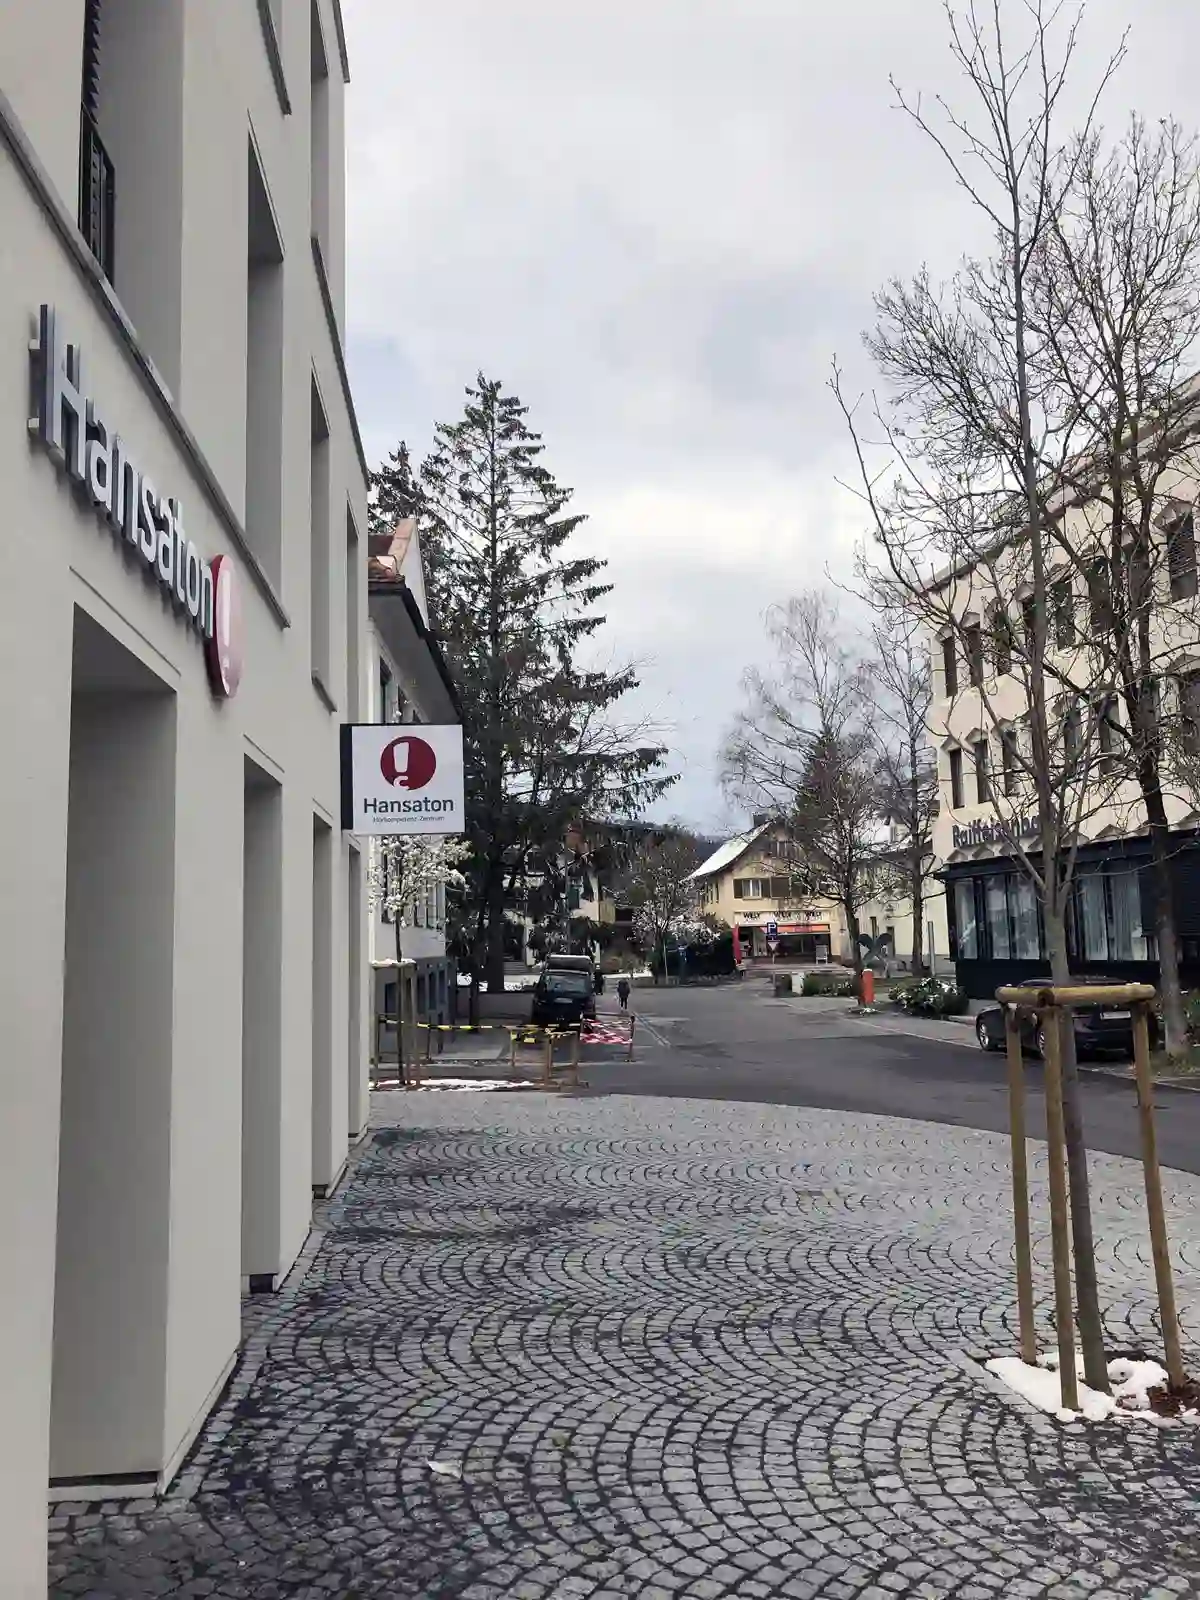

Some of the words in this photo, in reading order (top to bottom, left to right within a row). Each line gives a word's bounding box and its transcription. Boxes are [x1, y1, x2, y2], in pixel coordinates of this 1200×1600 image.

[38, 303, 214, 640] Hansaton
[363, 796, 454, 813] Hansaton
[768, 923, 777, 933] P
